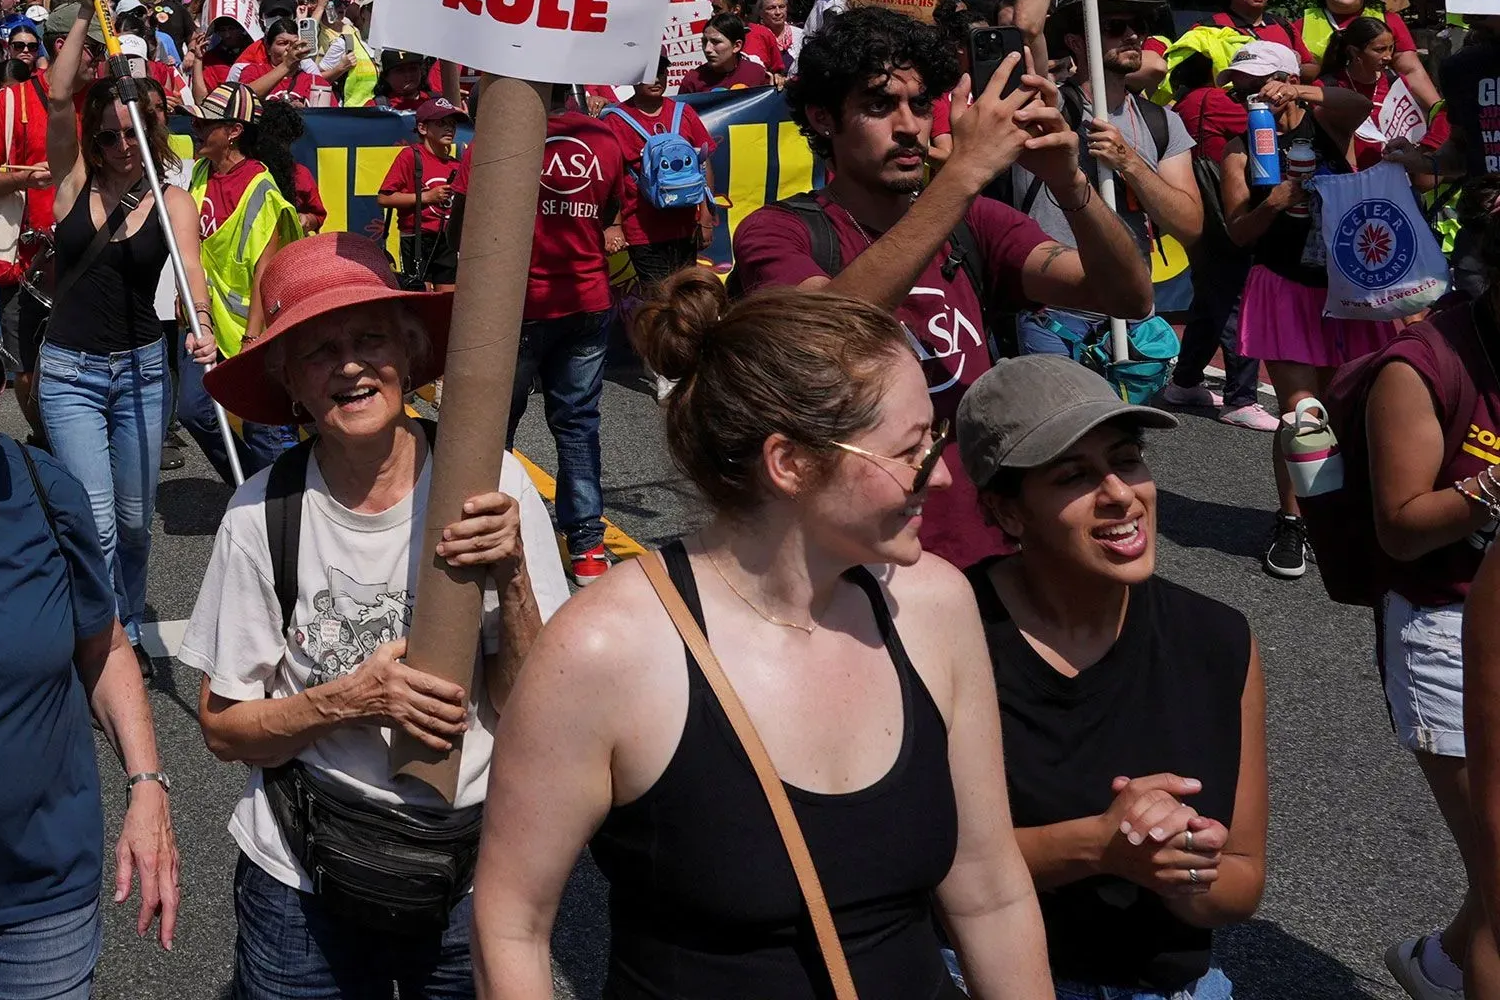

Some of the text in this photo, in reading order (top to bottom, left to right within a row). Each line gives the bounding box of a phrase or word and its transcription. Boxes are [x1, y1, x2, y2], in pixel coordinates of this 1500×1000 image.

[664, 40, 703, 57] AVE
[540, 152, 605, 182] ASA
[541, 199, 558, 215] SE
[1351, 252, 1408, 284] ICELAND
